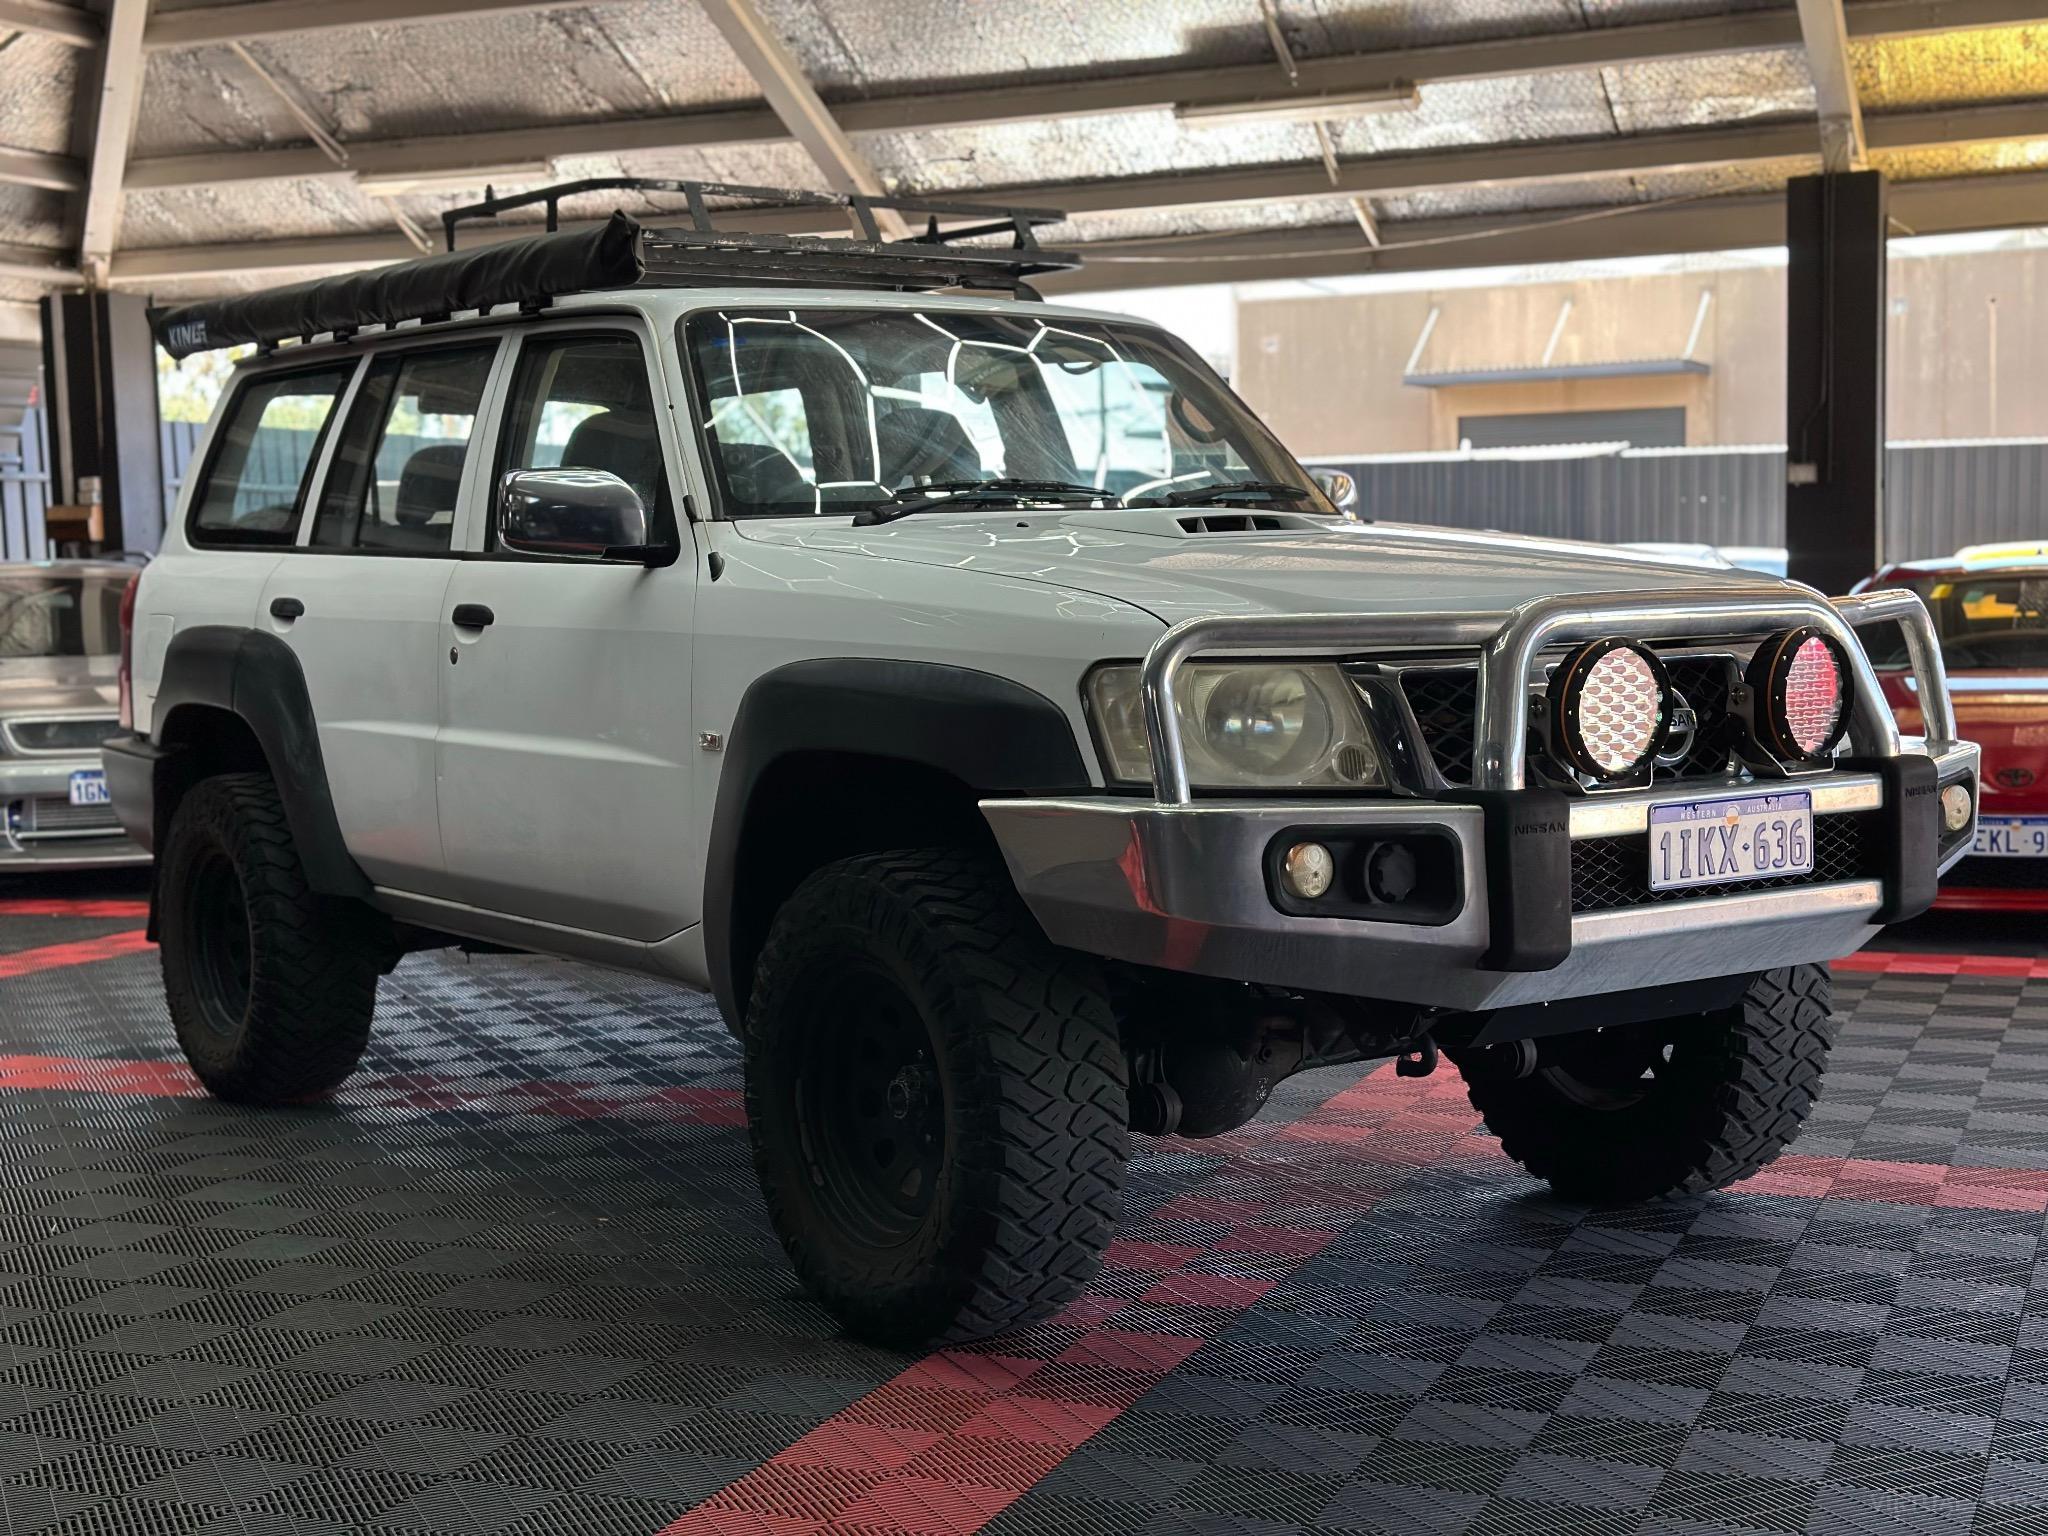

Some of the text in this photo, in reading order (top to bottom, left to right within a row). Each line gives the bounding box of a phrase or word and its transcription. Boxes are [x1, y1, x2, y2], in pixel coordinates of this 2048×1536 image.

[1680, 802, 1782, 820] WESTERN AUSTRALIA
[1514, 821, 1566, 835] NISSAN
